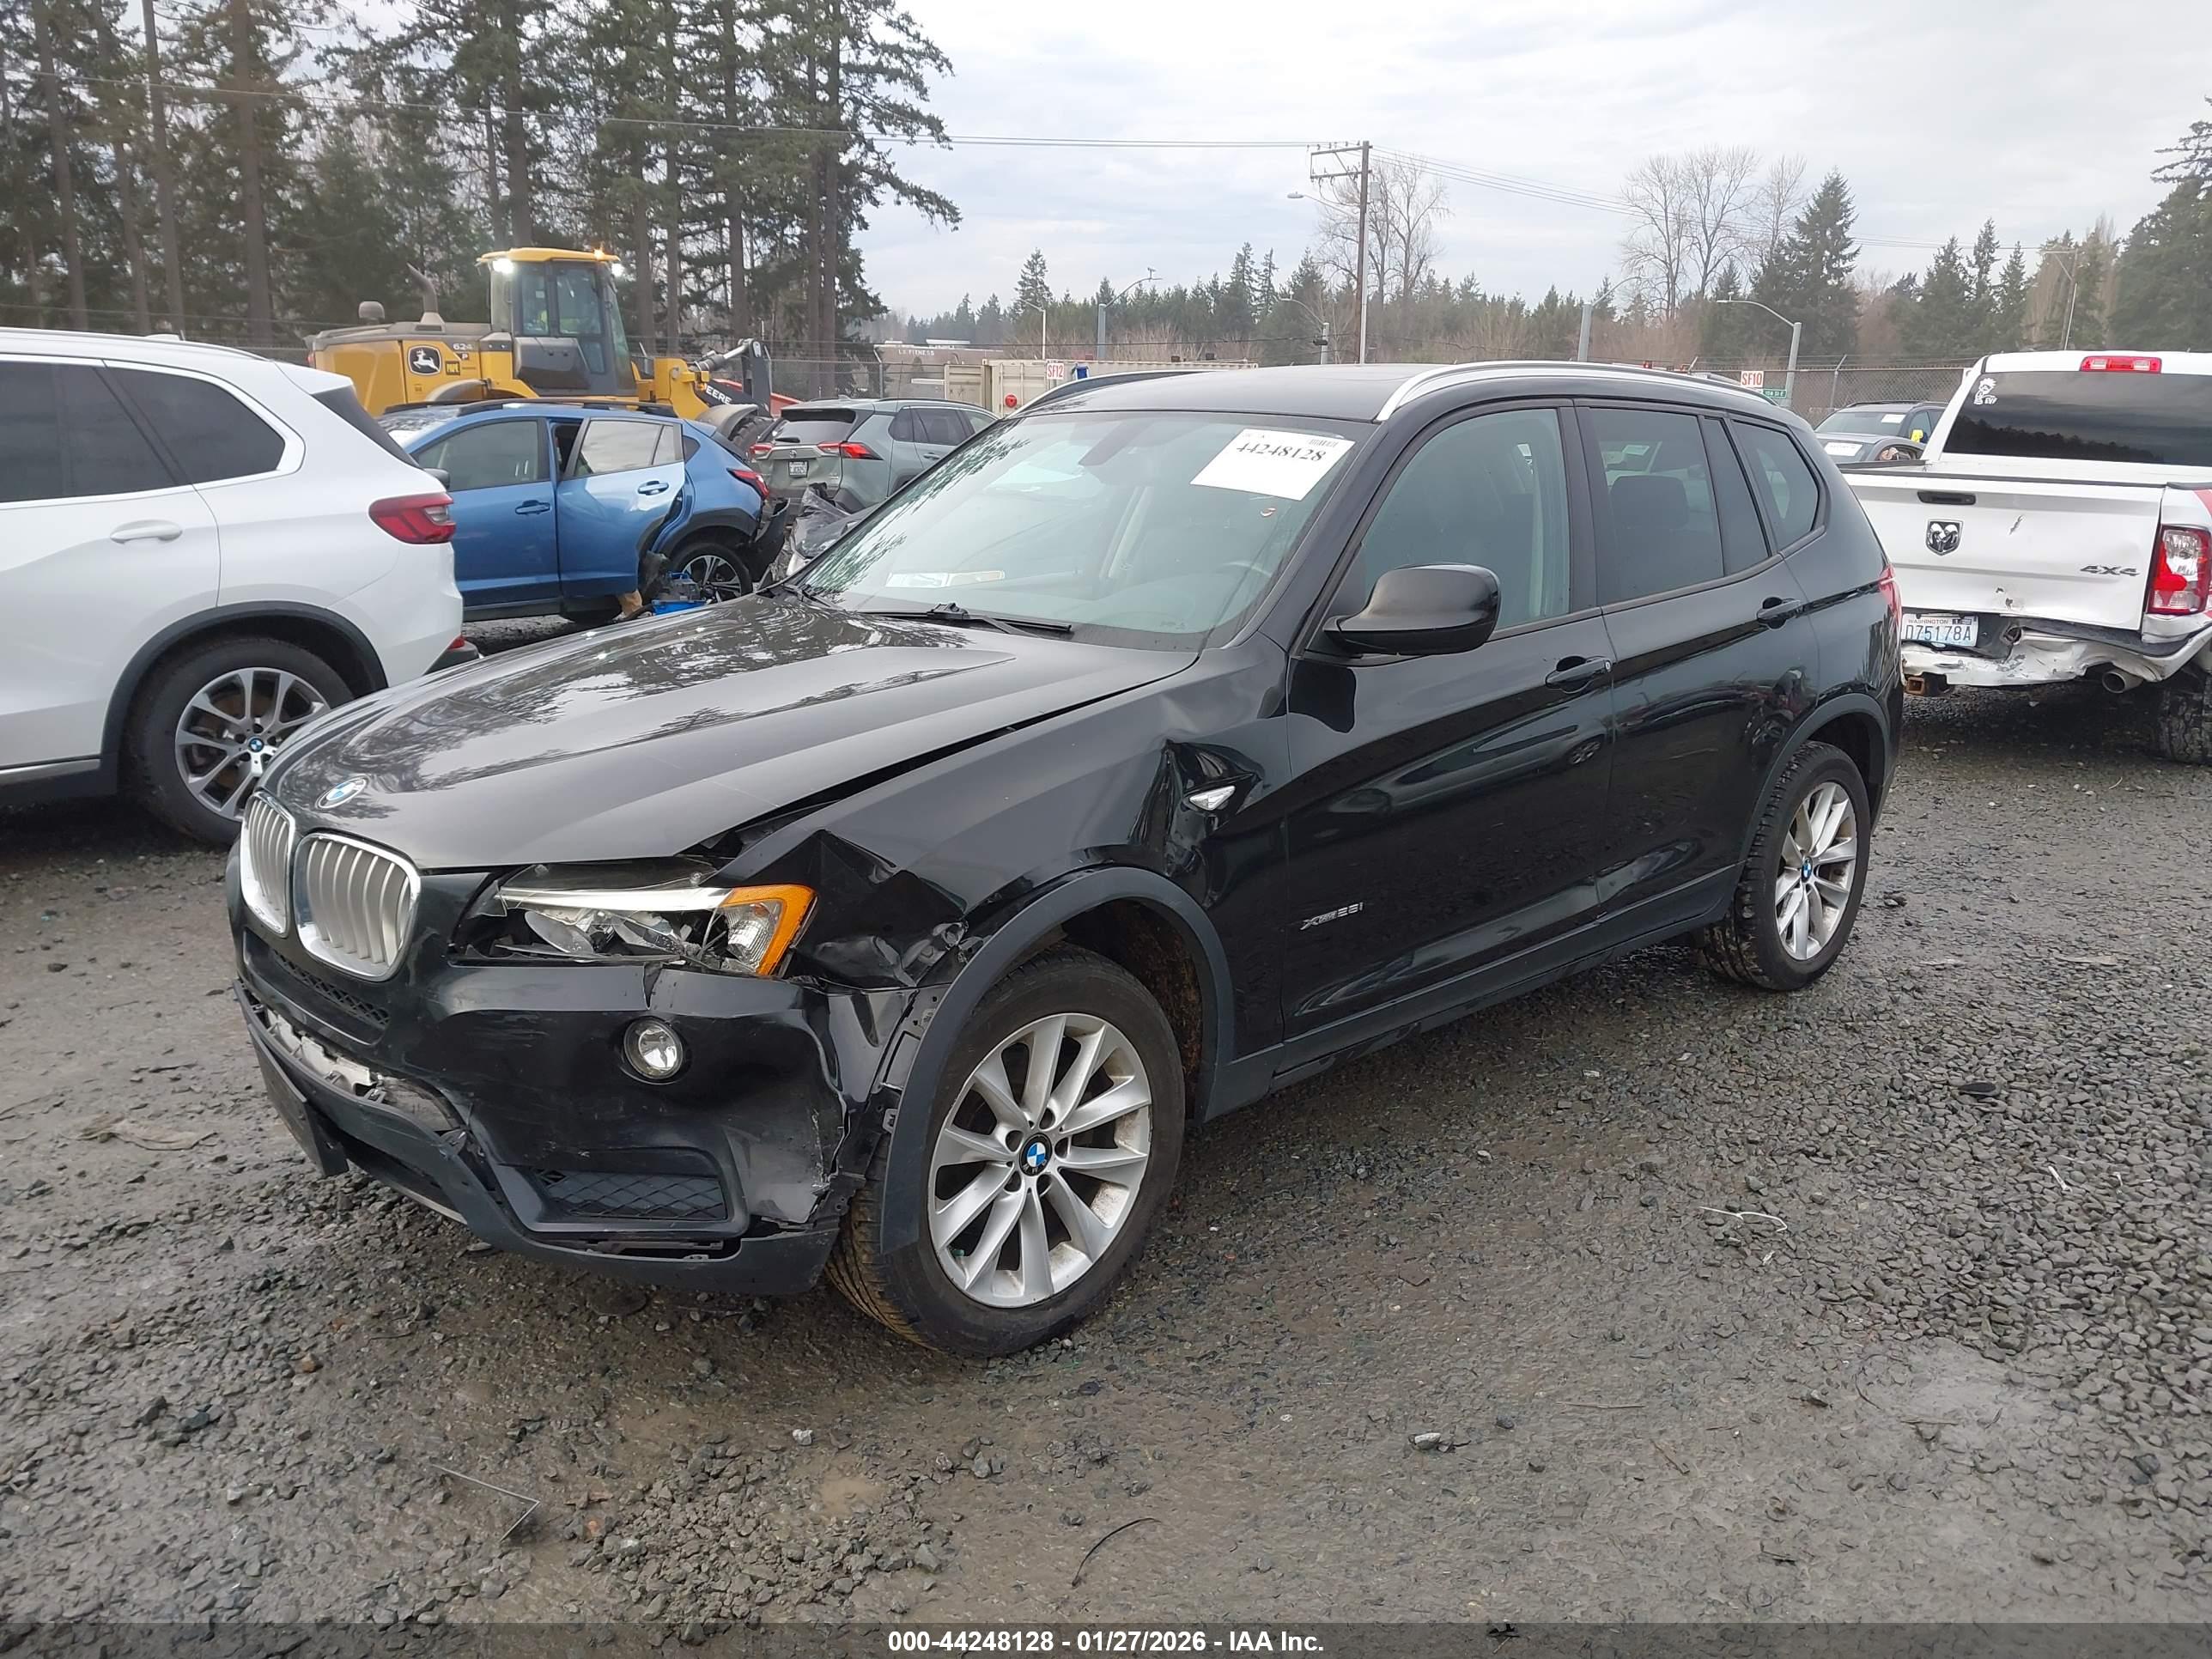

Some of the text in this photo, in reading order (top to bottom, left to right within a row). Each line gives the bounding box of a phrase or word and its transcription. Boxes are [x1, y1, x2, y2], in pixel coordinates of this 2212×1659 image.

[1048, 364, 1064, 378] SF12
[1741, 372, 1763, 386] SF10
[704, 383, 732, 404] EERE
[1237, 441, 1327, 462] 44248128
